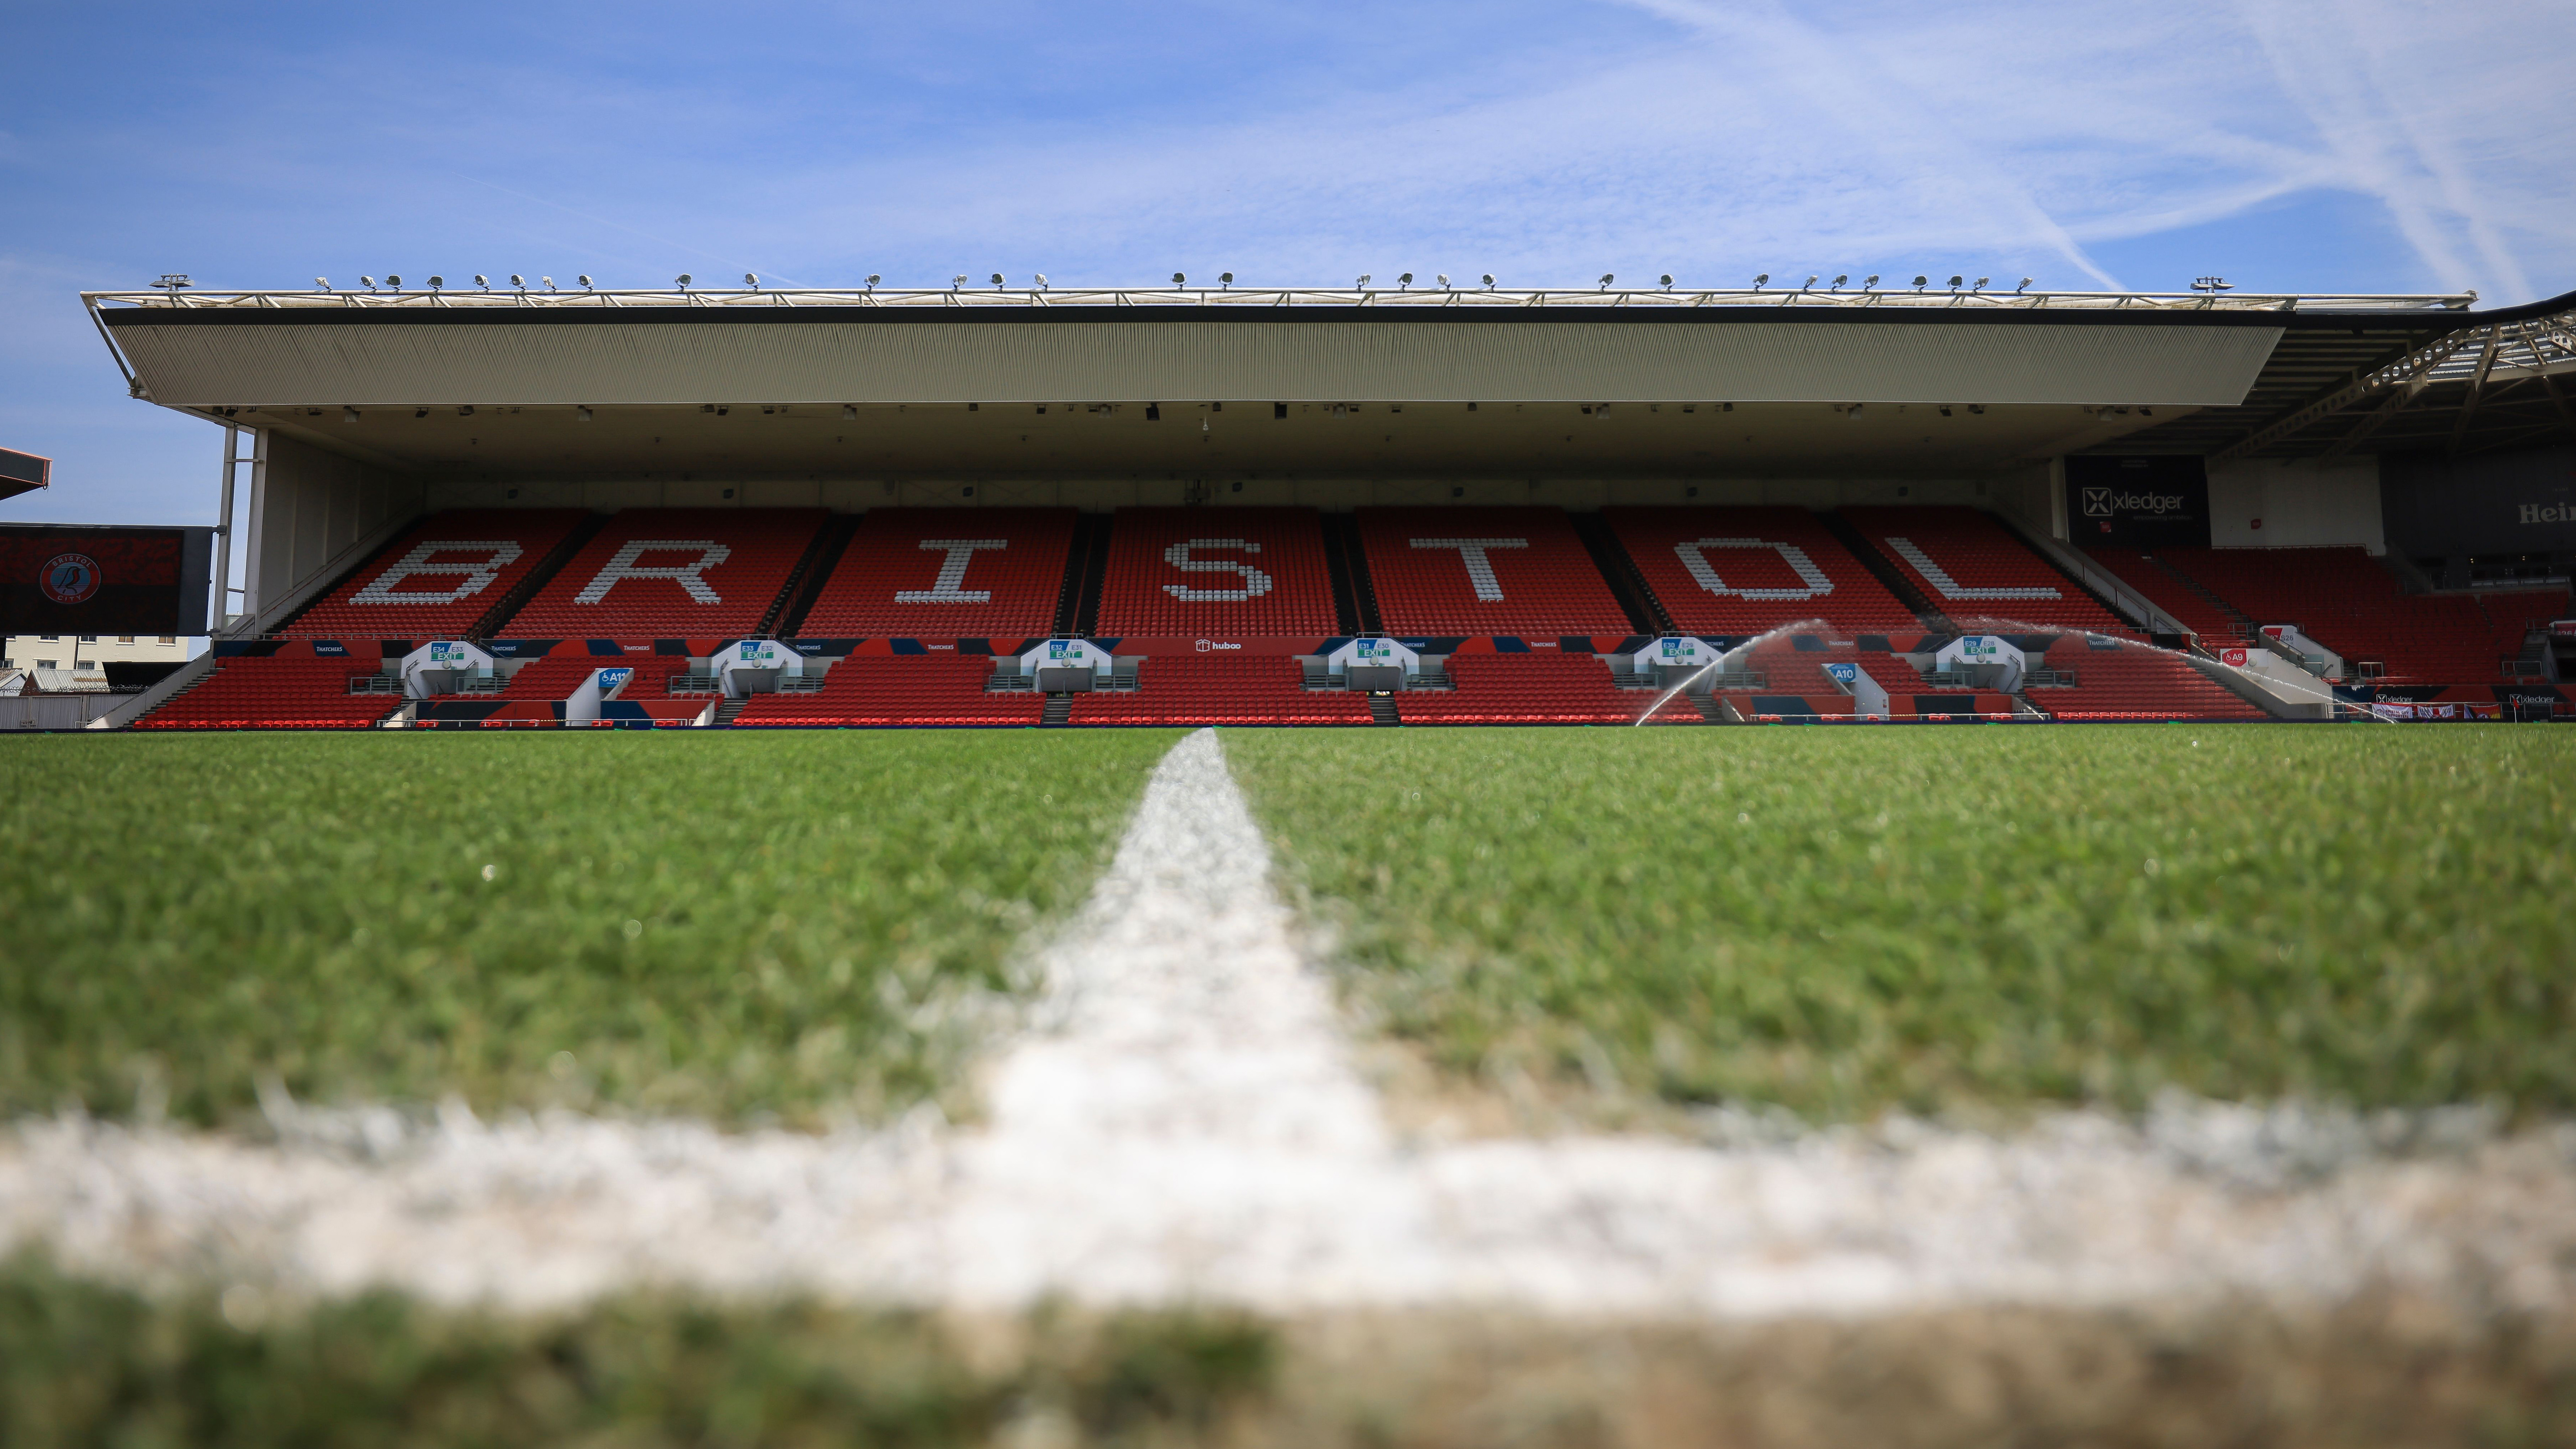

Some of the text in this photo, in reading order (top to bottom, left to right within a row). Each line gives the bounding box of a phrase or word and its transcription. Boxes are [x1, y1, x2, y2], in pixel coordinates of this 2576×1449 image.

[2113, 491, 2184, 513] xledger
[52, 556, 91, 568] BRISTOL
[348, 538, 2062, 605] BRISTOL
[1836, 670, 1853, 678] A10
